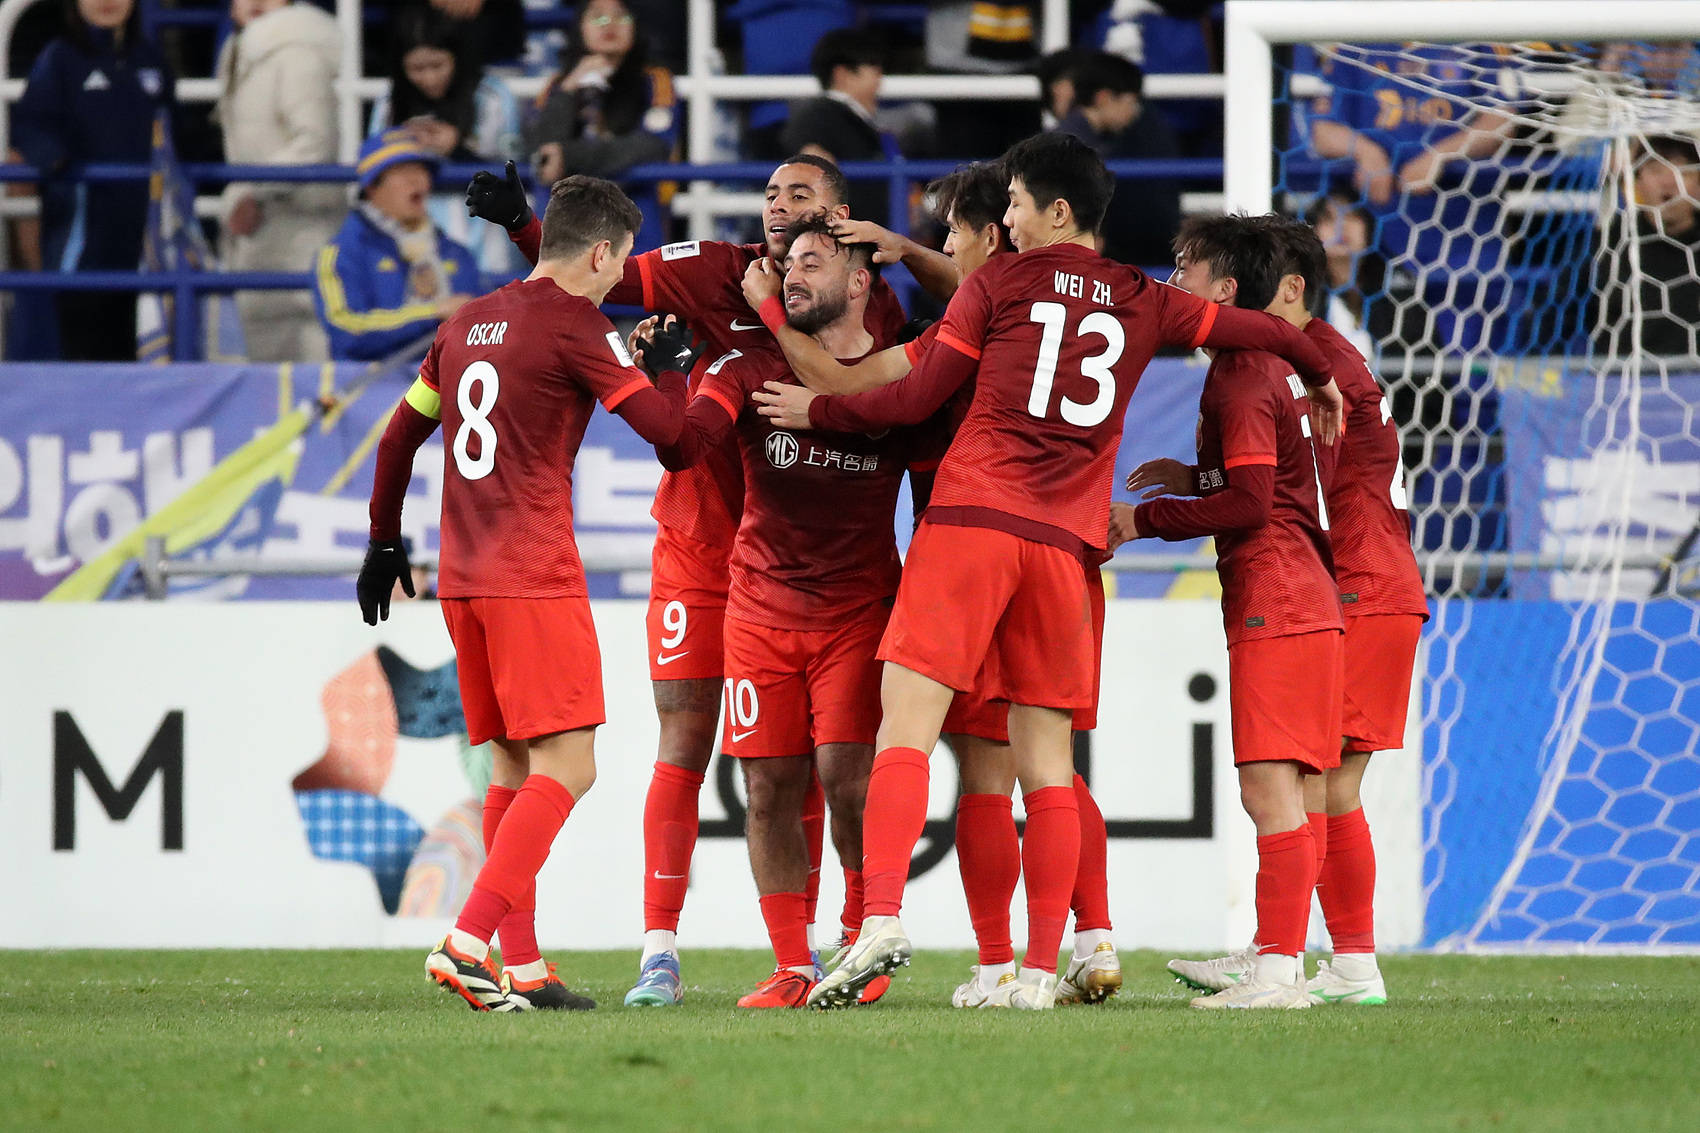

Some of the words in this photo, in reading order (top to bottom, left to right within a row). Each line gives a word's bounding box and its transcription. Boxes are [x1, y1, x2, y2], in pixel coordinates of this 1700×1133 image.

[1054, 270, 1084, 299] WEI
[1092, 280, 1115, 307] ZH.
[466, 321, 508, 346] OSCAR
[1027, 302, 1126, 427] 13
[453, 360, 500, 480] 8
[767, 434, 797, 466] MG
[803, 446, 879, 472] 上汽名爵
[660, 599, 688, 650] 9
[725, 677, 760, 728] 10
